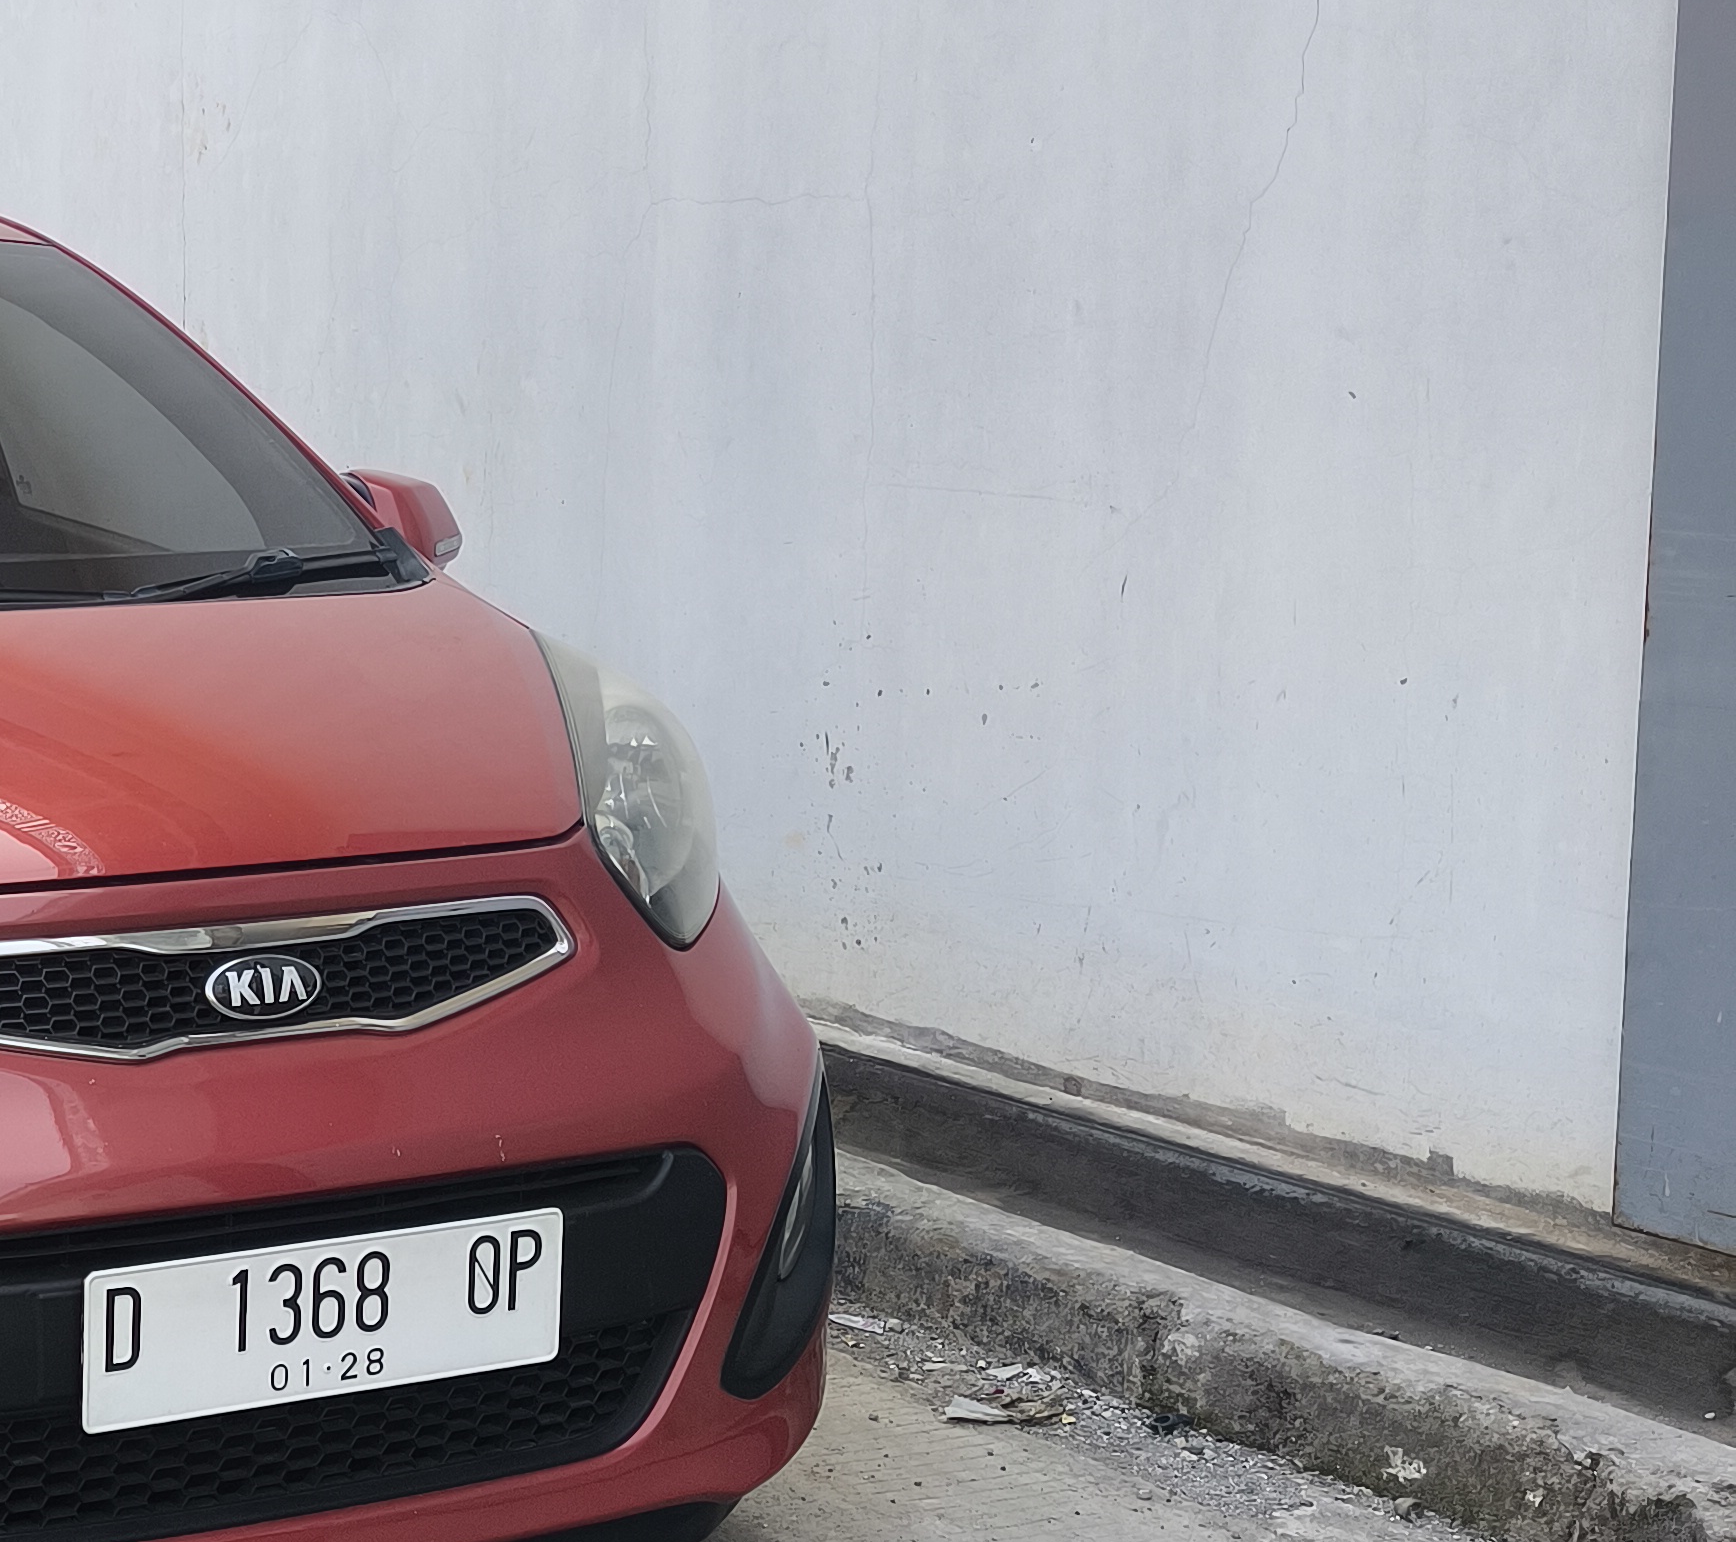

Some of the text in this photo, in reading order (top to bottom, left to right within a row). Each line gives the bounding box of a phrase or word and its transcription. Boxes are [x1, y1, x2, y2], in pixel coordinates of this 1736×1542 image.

[225, 965, 307, 1007] KIA
[105, 1287, 141, 1373] D
[231, 1251, 390, 1352] 1368
